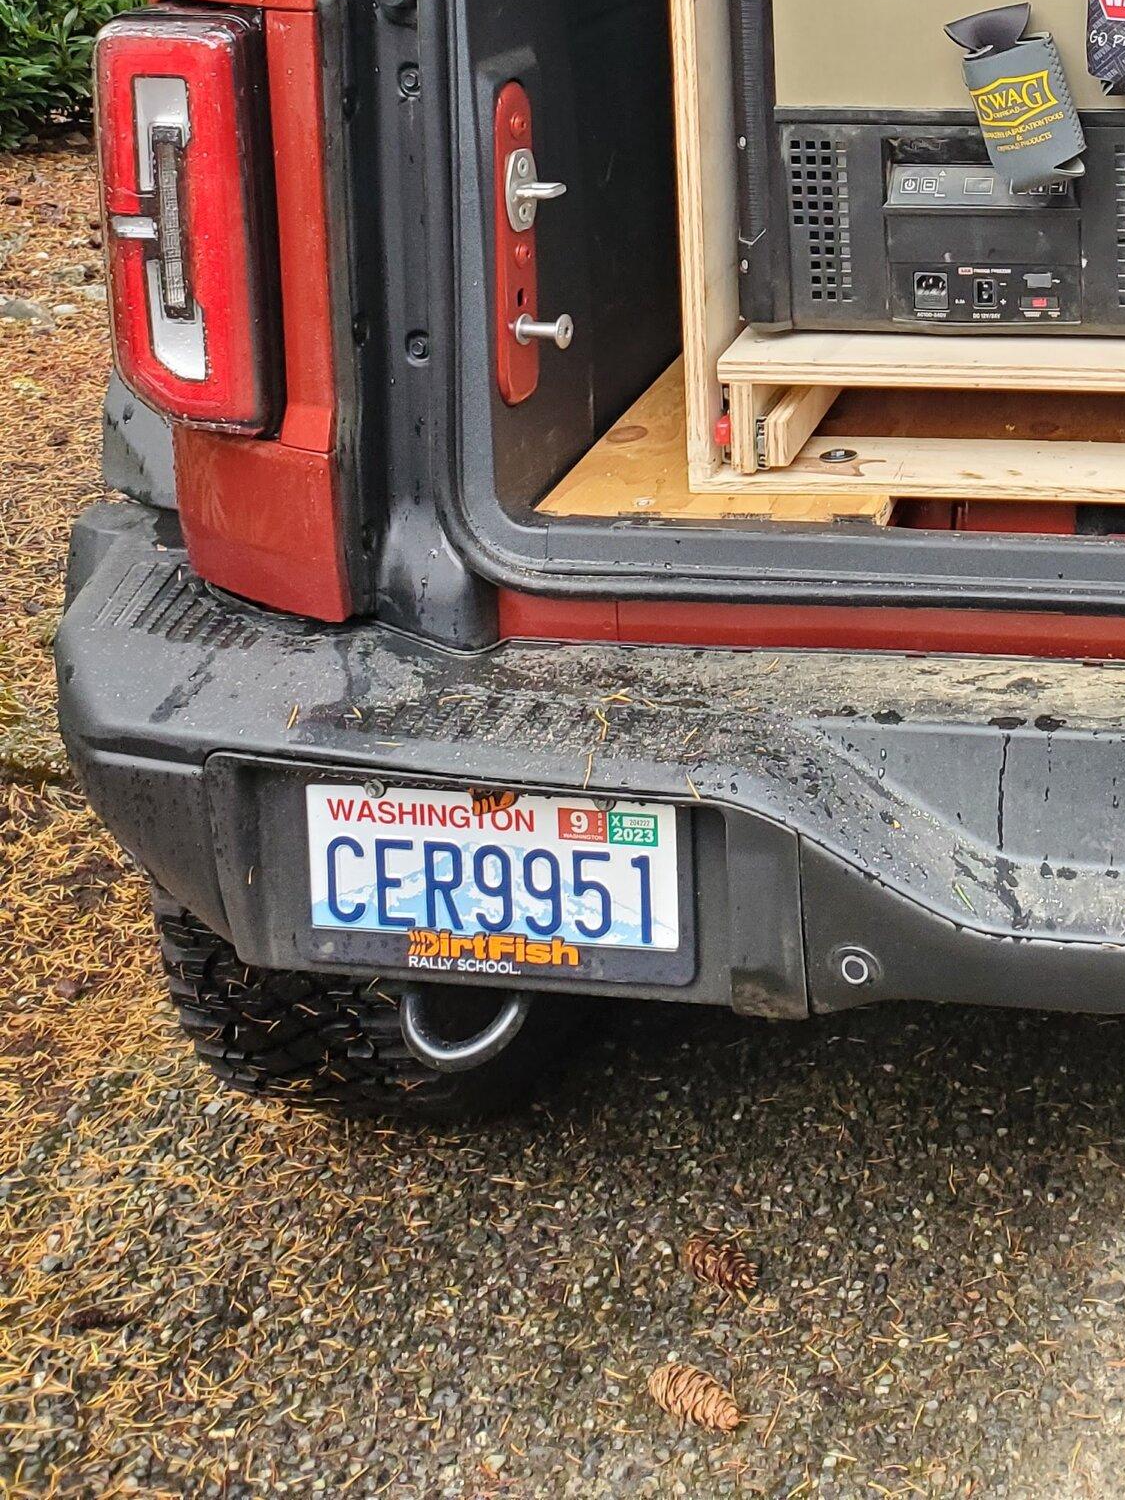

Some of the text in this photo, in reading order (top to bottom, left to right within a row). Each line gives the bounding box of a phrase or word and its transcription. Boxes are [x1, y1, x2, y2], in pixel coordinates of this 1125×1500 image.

[1089, 30, 1108, 47] GO
[978, 80, 1043, 121] SWAG
[1044, 111, 1064, 125] TOOLS
[570, 811, 589, 834] 9
[611, 815, 620, 827] X
[563, 833, 604, 841] WASHINGTON
[612, 827, 655, 843] 2023
[326, 835, 653, 944] CER9951
[408, 930, 580, 966] DirtFish
[408, 955, 454, 971] RALLY
